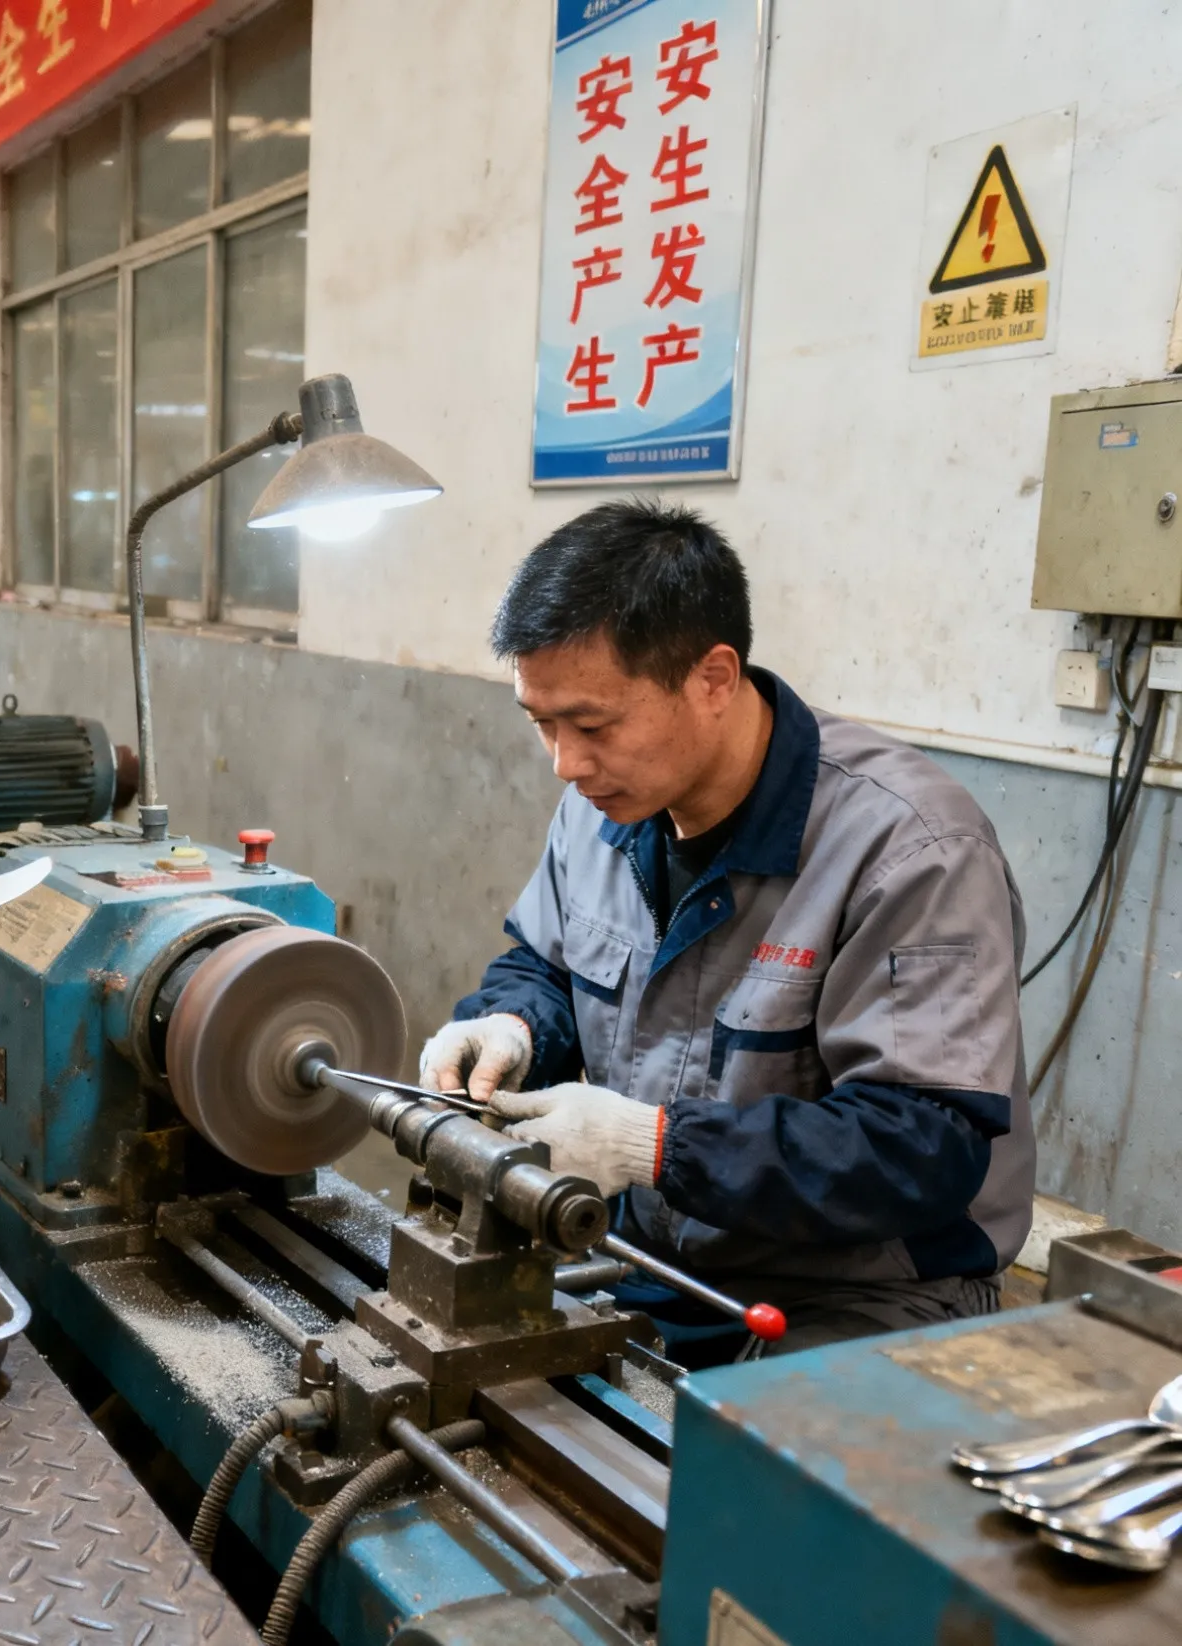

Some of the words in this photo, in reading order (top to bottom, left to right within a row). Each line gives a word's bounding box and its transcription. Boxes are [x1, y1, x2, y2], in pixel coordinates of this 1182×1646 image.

[566, 55, 633, 413] 安全产生
[636, 20, 719, 408] 安生发产
